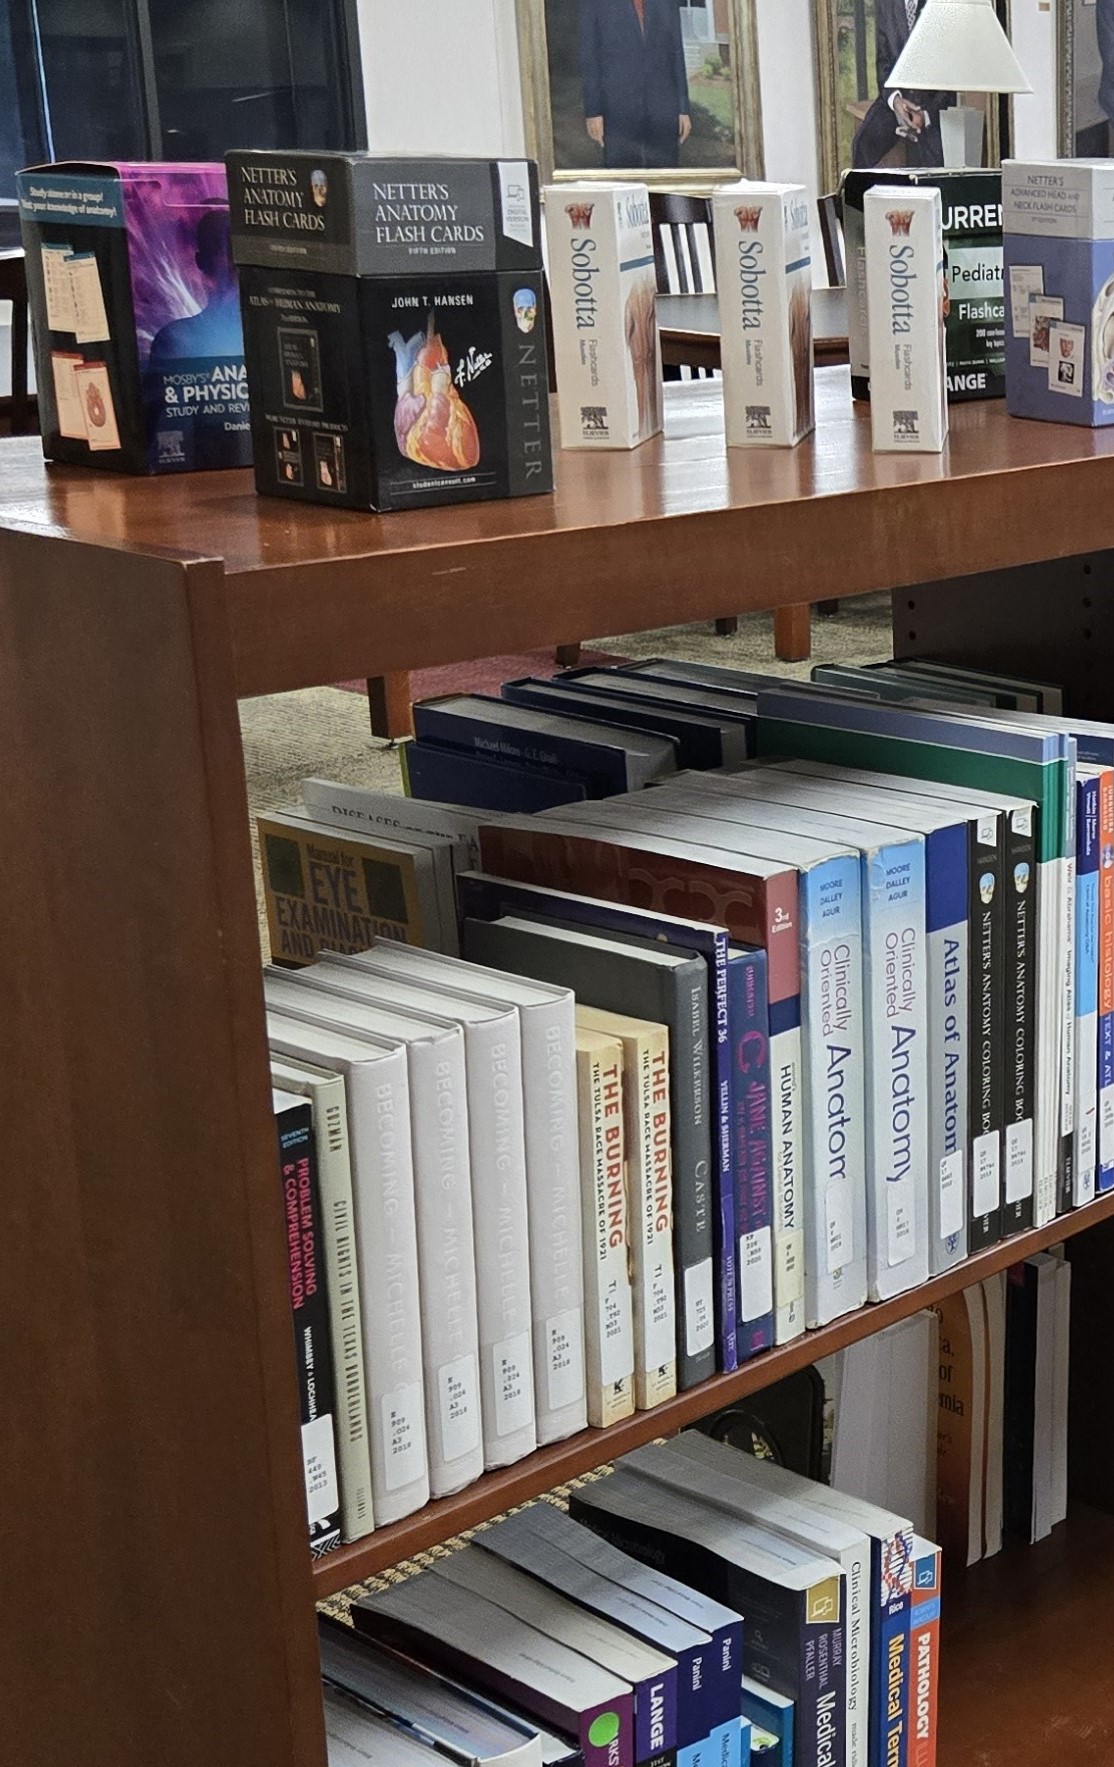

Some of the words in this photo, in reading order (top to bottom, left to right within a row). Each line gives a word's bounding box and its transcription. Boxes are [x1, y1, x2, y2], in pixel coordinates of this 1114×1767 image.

[241, 166, 297, 186] NETTER'S
[244, 187, 304, 208] ANATOMY
[373, 183, 449, 200] NETTER'S
[1010, 189, 1047, 200] ADVANCED
[1047, 190, 1066, 200] HEAD
[1027, 175, 1064, 186] NETTER'S
[245, 208, 279, 227] FLASH
[282, 212, 325, 231] CARDS
[375, 204, 458, 222] ANATOMY
[376, 226, 425, 243] FLASH
[430, 225, 484, 242] CARDS
[391, 296, 419, 308] JOHN
[434, 294, 474, 306] HANSEN
[570, 238, 600, 331] Sobotta
[738, 240, 766, 332] Sobotta
[889, 244, 917, 336] Sobotta
[165, 386, 179, 403] &
[166, 405, 199, 418] STUDY
[203, 403, 225, 414] AND
[518, 345, 543, 480] NETTER
[309, 861, 362, 914] EYE
[820, 878, 844, 891] MOORE
[886, 863, 911, 876] MOORE
[886, 876, 911, 890] DALLEY
[276, 896, 407, 945] EXAMINATION
[820, 892, 843, 905] DALLEY
[822, 906, 840, 917] AGUR
[888, 890, 908, 901] AGUR
[1104, 875, 1112, 926] basic
[771, 921, 793, 933] Edition
[982, 911, 992, 970] NETTER'S
[1016, 899, 1026, 958] NETTER'S
[715, 938, 727, 968] THE
[885, 932, 900, 1018] Oriented
[898, 927, 916, 1012] Clinically
[943, 939, 960, 1007] Atlas
[1103, 930, 1113, 1009] histology
[691, 986, 702, 1037] ISABEL
[715, 968, 728, 1026] PERFECT
[820, 949, 834, 1037] Oriented
[833, 943, 852, 1031] Clinically
[982, 973, 991, 1036] ANATOMY
[1015, 961, 1026, 1024] ANATOMY
[718, 1028, 728, 1043] 36
[944, 1015, 961, 1044] of
[1104, 1014, 1112, 1045] TEXT
[1104, 1050, 1111, 1060] &
[653, 1050, 666, 1104] THE
[693, 1039, 704, 1125] WILKERSON
[981, 1040, 991, 1109] COLORING
[1015, 1027, 1025, 1095] COLORING
[491, 1042, 512, 1170] BECOMING
[546, 1025, 565, 1151] BECOMING
[603, 1063, 620, 1118] THE
[720, 1080, 729, 1114] YELLIN
[780, 1064, 793, 1135] HUMAN
[886, 1025, 917, 1182] Anatomy
[281, 1127, 310, 1141] SEVENTH
[282, 1135, 308, 1149] EDITION
[376, 1083, 399, 1215] BECOMING
[435, 1061, 455, 1191] BECOMING
[722, 1125, 731, 1173] SHERMAN
[283, 1163, 295, 1176] &
[297, 1157, 313, 1229] PROBLEM
[596, 1158, 605, 1217] MASSACRE
[605, 1125, 623, 1248] BURNING
[645, 1144, 653, 1201] MASSACRE
[653, 1112, 668, 1233] BURNING
[782, 1140, 794, 1229] ANATOMY
[333, 1200, 349, 1231] CIVIL
[646, 1204, 653, 1219] OF
[694, 1160, 708, 1232] CASTE
[285, 1178, 304, 1310] COMPREHENSION
[598, 1219, 606, 1234] OF
[599, 1237, 607, 1261] 1921
[646, 1222, 654, 1245] 1921
[302, 1231, 317, 1296] SOLVING
[336, 1236, 352, 1278] RIGHTS
[339, 1282, 353, 1295] IN
[341, 1300, 355, 1320] THE
[303, 1326, 314, 1370] WHIMBEY
[342, 1325, 358, 1360] TEXAS
[345, 1364, 363, 1442] BORDERLANDS
[851, 1561, 861, 1617] Clinical
[888, 1601, 904, 1615] Rice
[722, 1637, 732, 1671] Panini
[805, 1639, 816, 1681] PFALLER
[818, 1633, 829, 1690] ROSENTHAL
[832, 1627, 842, 1667] MURRAY
[848, 1619, 861, 1711] Microbiology
[692, 1656, 702, 1691] Panini
[887, 1633, 905, 1722] Medical
[916, 1632, 931, 1740] PATHOLOGY
[650, 1683, 664, 1750] LANGE
